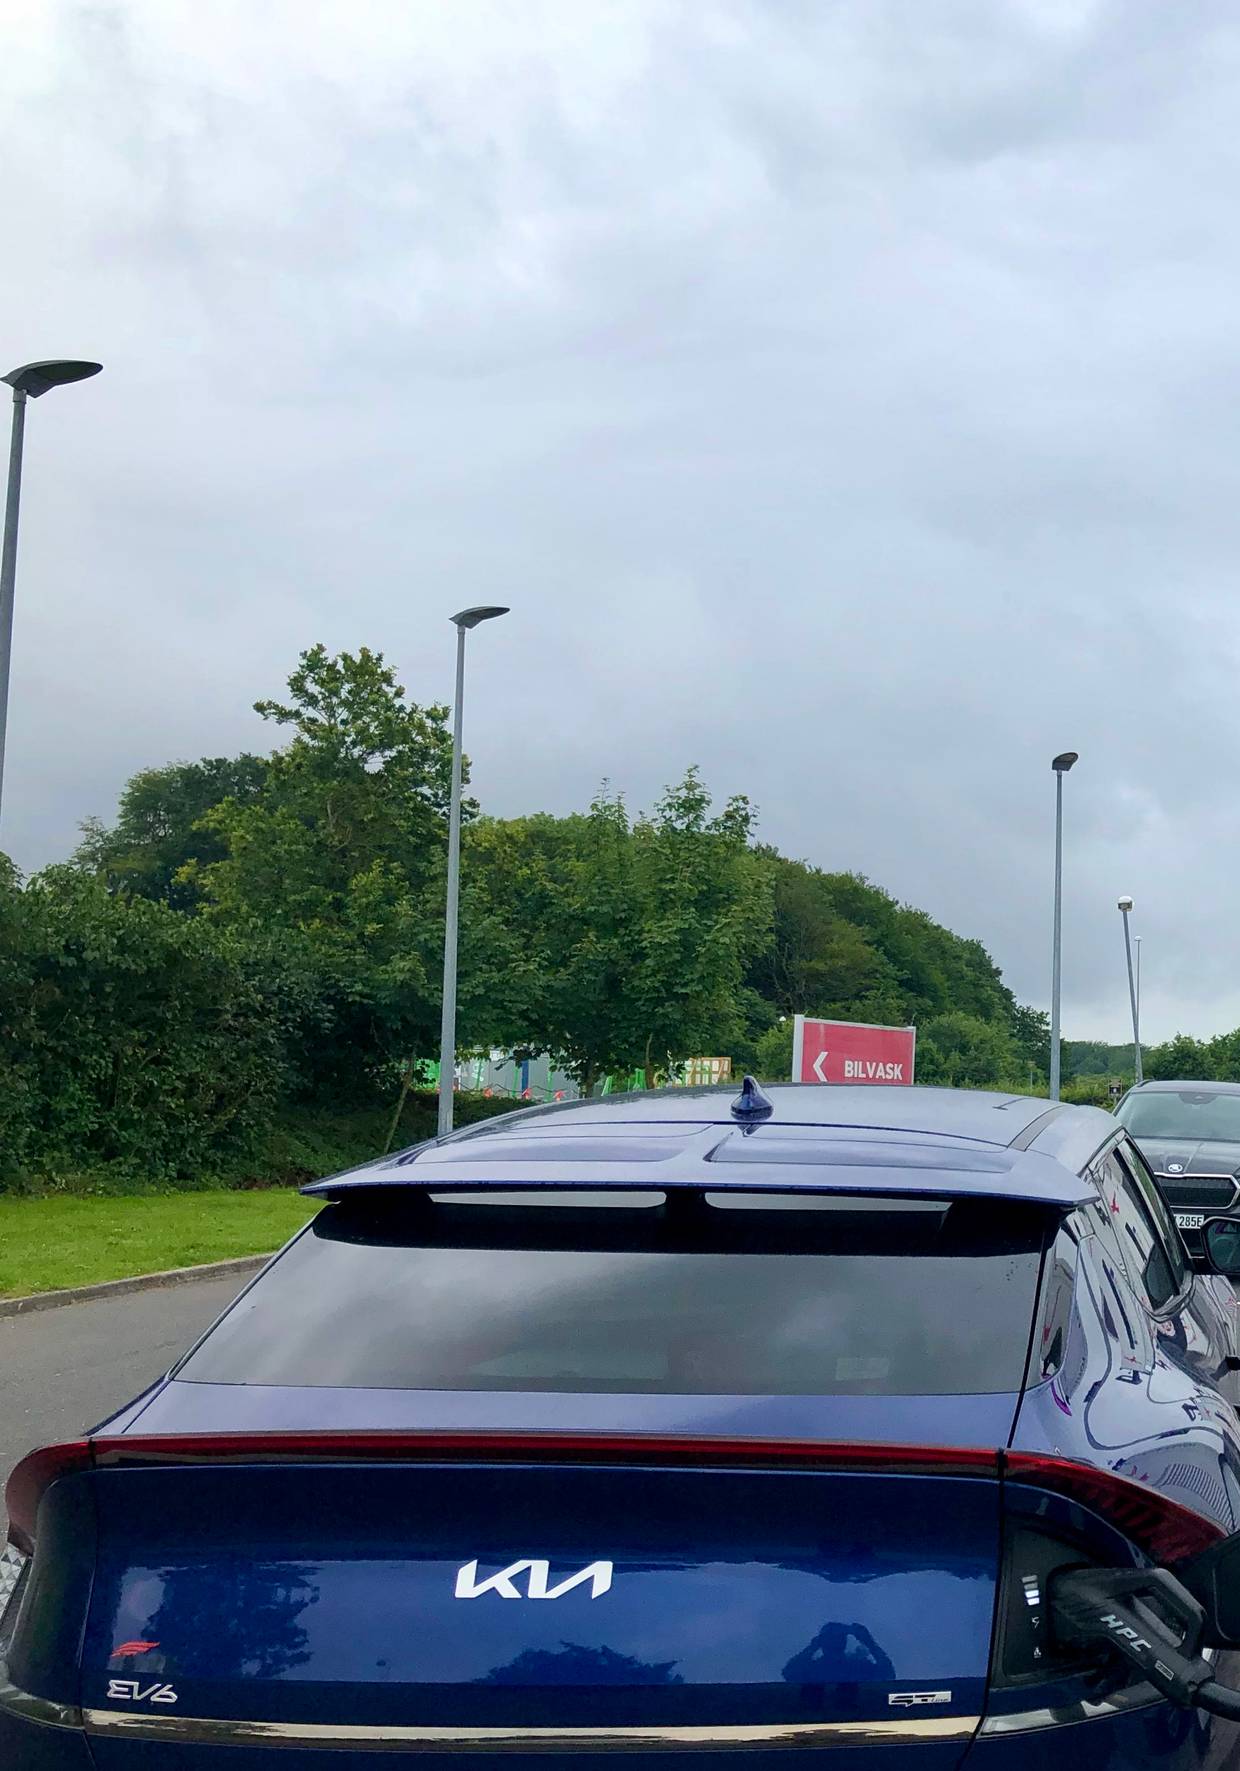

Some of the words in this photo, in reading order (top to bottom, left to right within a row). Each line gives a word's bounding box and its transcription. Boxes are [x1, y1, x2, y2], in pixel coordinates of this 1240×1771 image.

[844, 1060, 903, 1080] BILVASK
[455, 1559, 613, 1600] KIA
[1100, 1614, 1152, 1652] HPC
[107, 1679, 178, 1703] EV6
